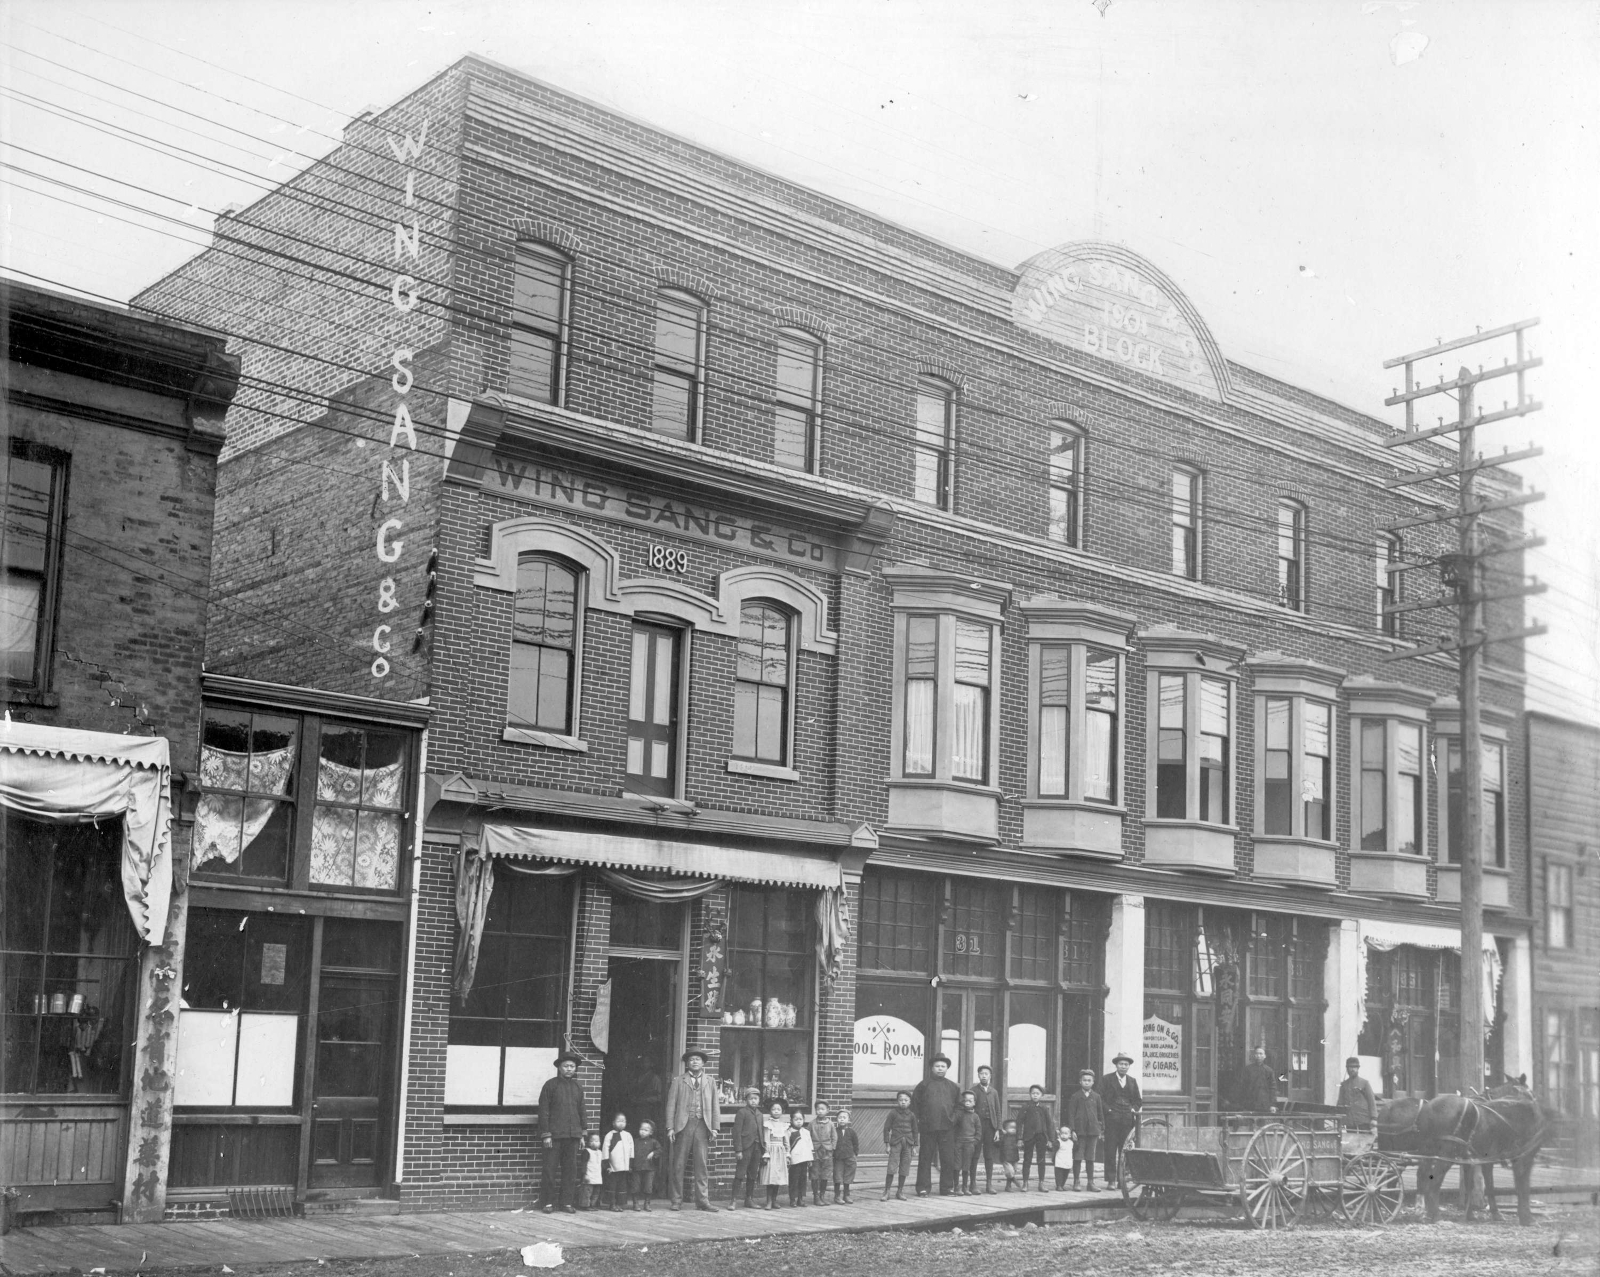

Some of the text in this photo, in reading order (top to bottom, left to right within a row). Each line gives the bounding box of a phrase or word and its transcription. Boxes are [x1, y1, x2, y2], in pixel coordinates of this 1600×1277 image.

[387, 118, 428, 312] WING
[1083, 323, 1164, 375] BLOCK
[376, 349, 417, 562] SANG
[494, 457, 608, 512] WING
[624, 491, 739, 542] SANG
[750, 524, 779, 553] &
[649, 544, 687, 573] 1889
[378, 576, 399, 612] &
[956, 934, 980, 955] 31
[853, 1040, 924, 1061] OOL ROOM.
[1165, 1027, 1171, 1038] &
